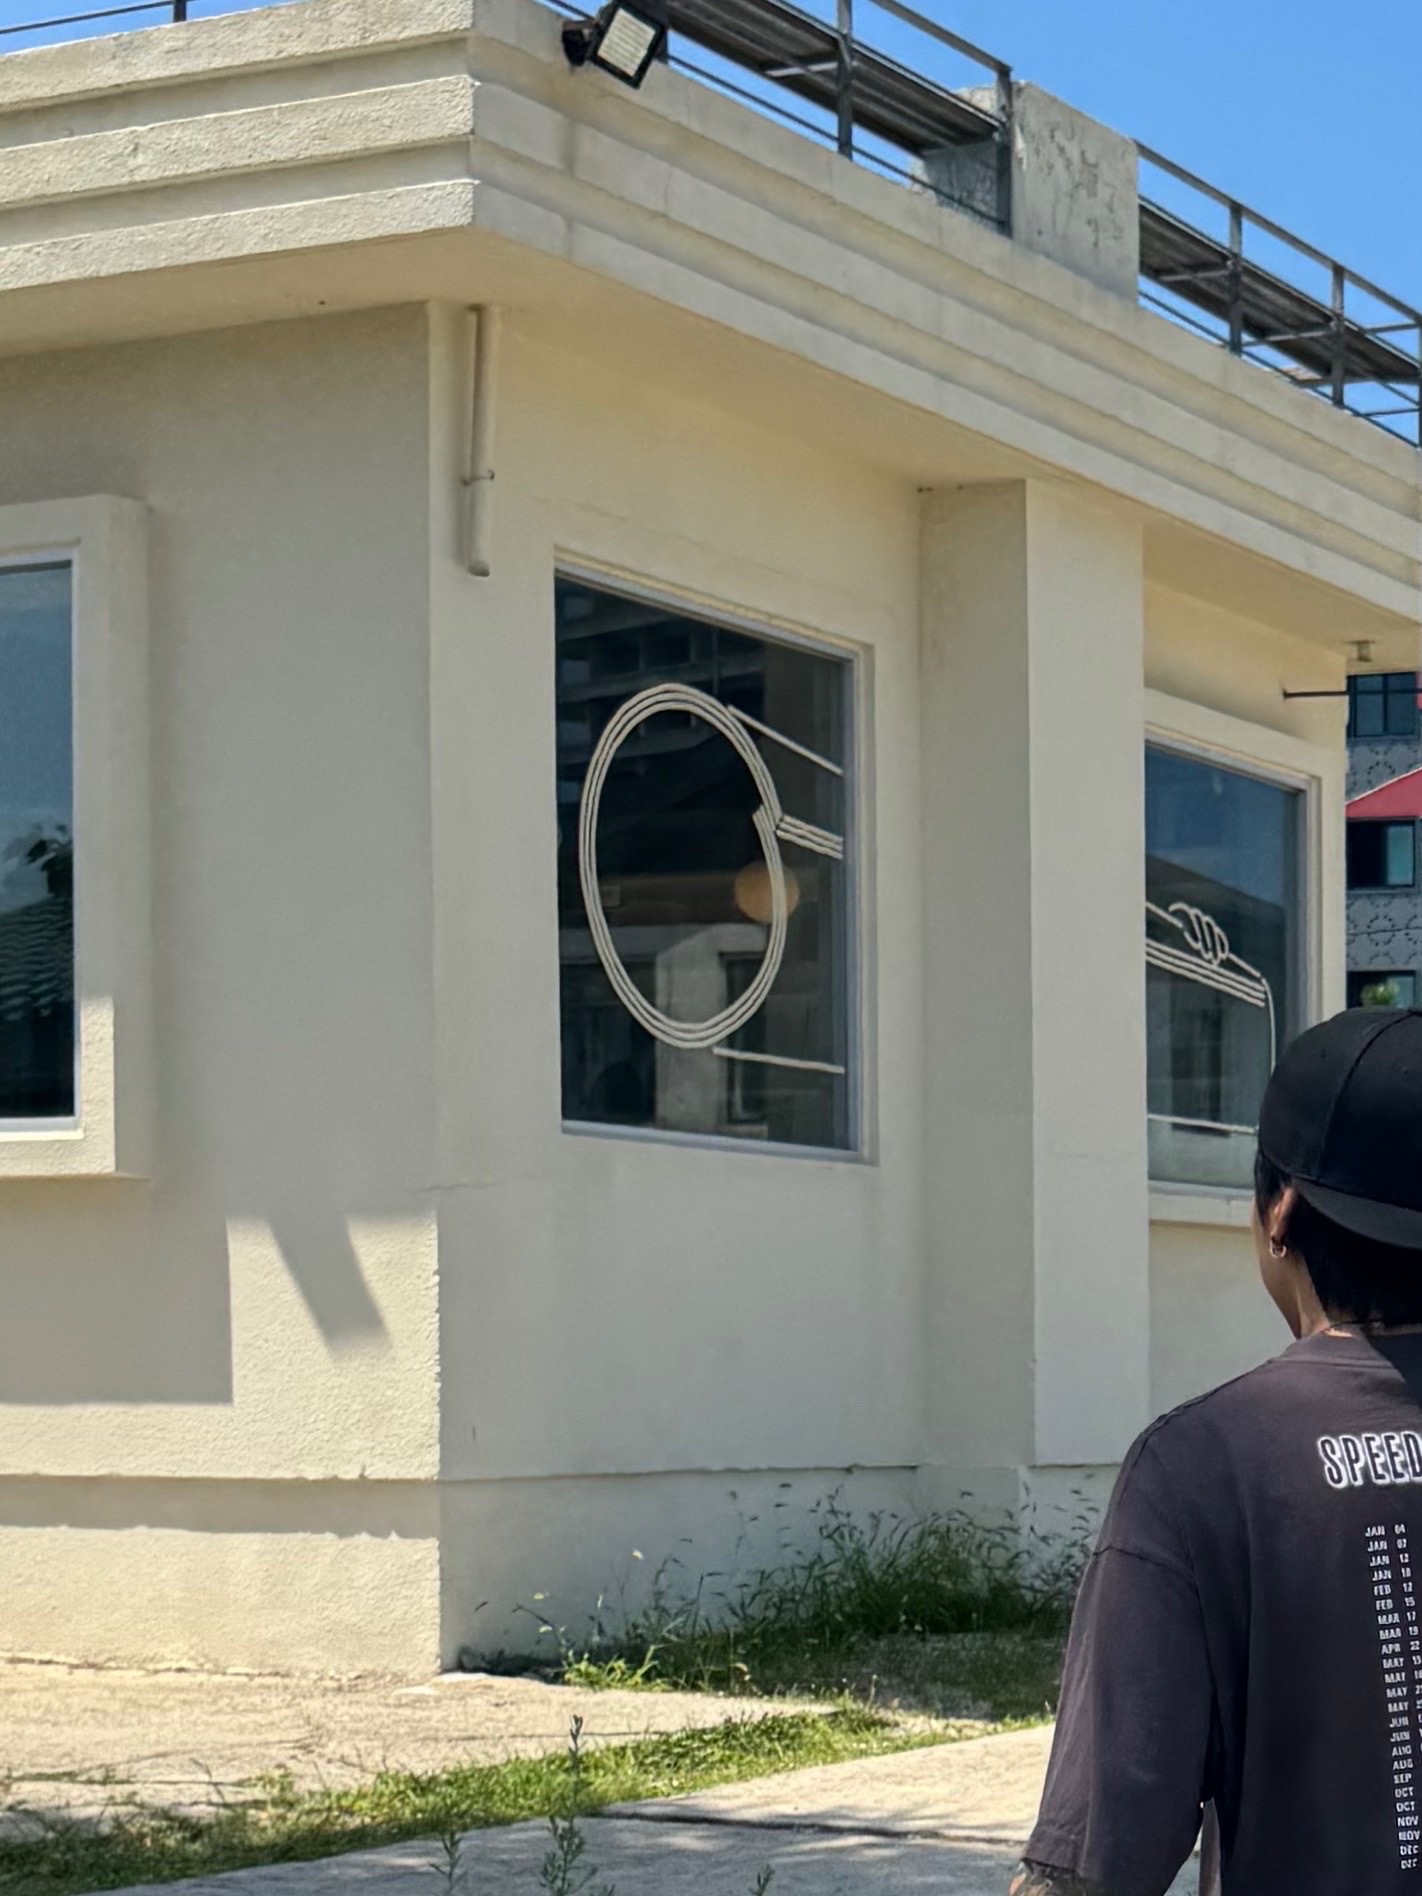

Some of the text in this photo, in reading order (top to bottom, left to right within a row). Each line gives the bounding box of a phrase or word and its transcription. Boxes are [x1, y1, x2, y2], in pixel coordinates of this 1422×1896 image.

[1365, 1525, 1386, 1537] JAN
[1367, 1540, 1388, 1552] JAN
[1369, 1555, 1390, 1567] JAN
[1372, 1569, 1392, 1581] JAN
[1381, 1643, 1401, 1655] APR
[1382, 1657, 1404, 1669] MAY
[1384, 1672, 1406, 1684] MAY
[1386, 1686, 1408, 1698] MAY
[1387, 1701, 1409, 1713] MAY
[1393, 1759, 1413, 1770] AUG
[1393, 1773, 1412, 1784] SEP
[1394, 1787, 1414, 1798] OCT
[1396, 1801, 1415, 1812] OCT
[1397, 1815, 1419, 1827] NOV
[1398, 1830, 1421, 1841] NOV
[1400, 1844, 1419, 1856] DEC
